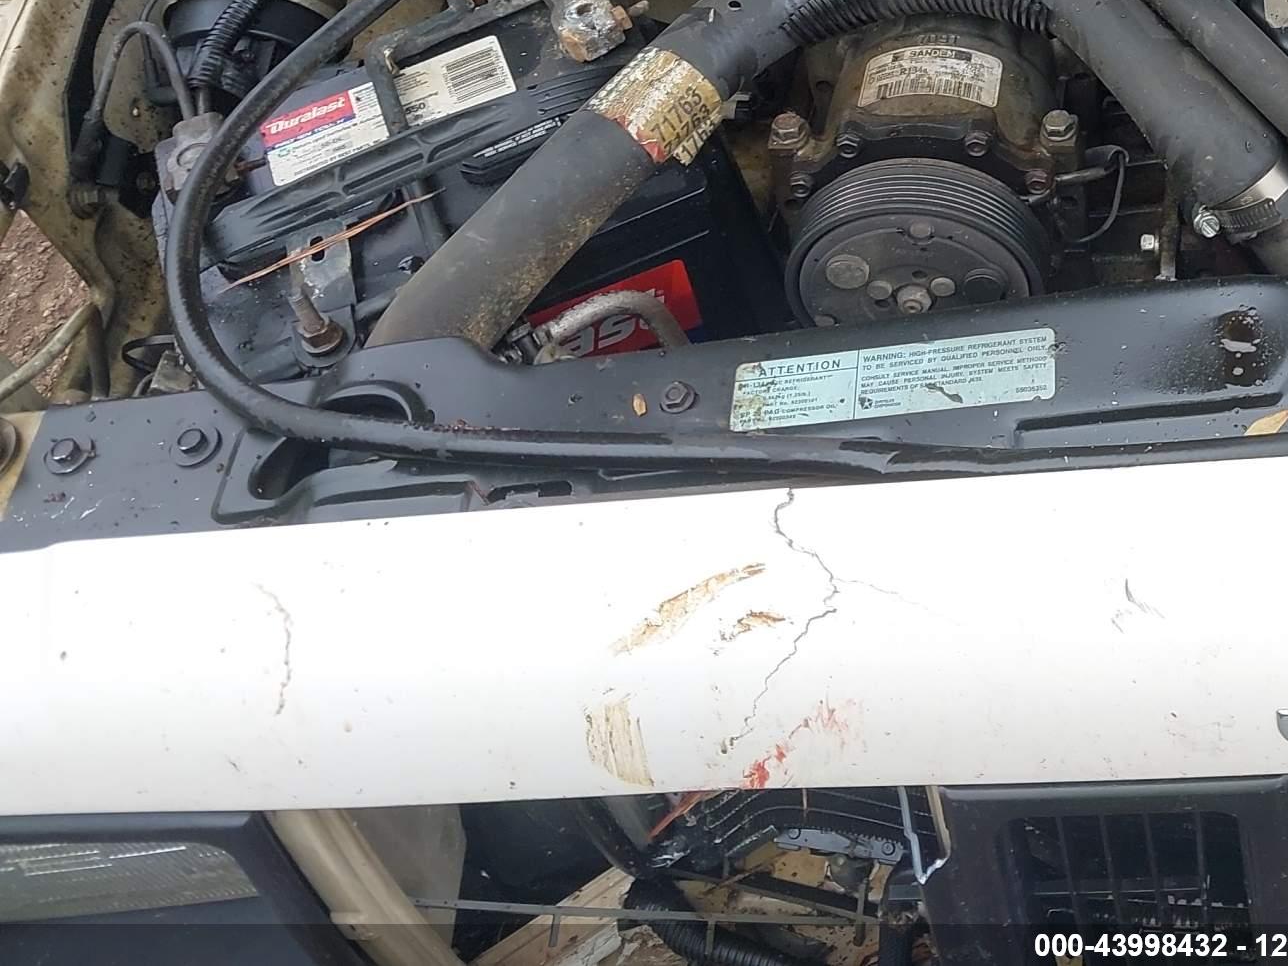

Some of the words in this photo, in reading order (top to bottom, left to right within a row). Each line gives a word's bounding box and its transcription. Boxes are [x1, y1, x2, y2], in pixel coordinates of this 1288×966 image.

[909, 48, 956, 58] SANDEN
[266, 96, 346, 134] Duralast
[863, 351, 906, 364] WARNING:
[909, 345, 965, 358] HIGH-PRESSURE
[967, 339, 1017, 350] REFRIGERANT
[1019, 336, 1047, 345] SYSTEM
[863, 363, 872, 371] TO
[889, 358, 924, 368] SERVICED
[940, 352, 978, 363] QUALIFIED
[981, 347, 1024, 358] PERSONNEL
[758, 359, 841, 377] ATTENTION
[861, 372, 890, 382] CONSULT
[893, 369, 919, 378] SERVICE
[952, 362, 986, 371] IMPROPER
[987, 359, 1014, 368] SERVICE
[878, 378, 900, 387] CAUSE
[903, 375, 938, 384] PERSONAL
[968, 367, 994, 377] SYSTEM
[998, 365, 1020, 373] MEETS
[1023, 362, 1047, 370] SAFETY
[860, 385, 909, 395] REQUIREMENTS
[909, 382, 920, 391] OF
